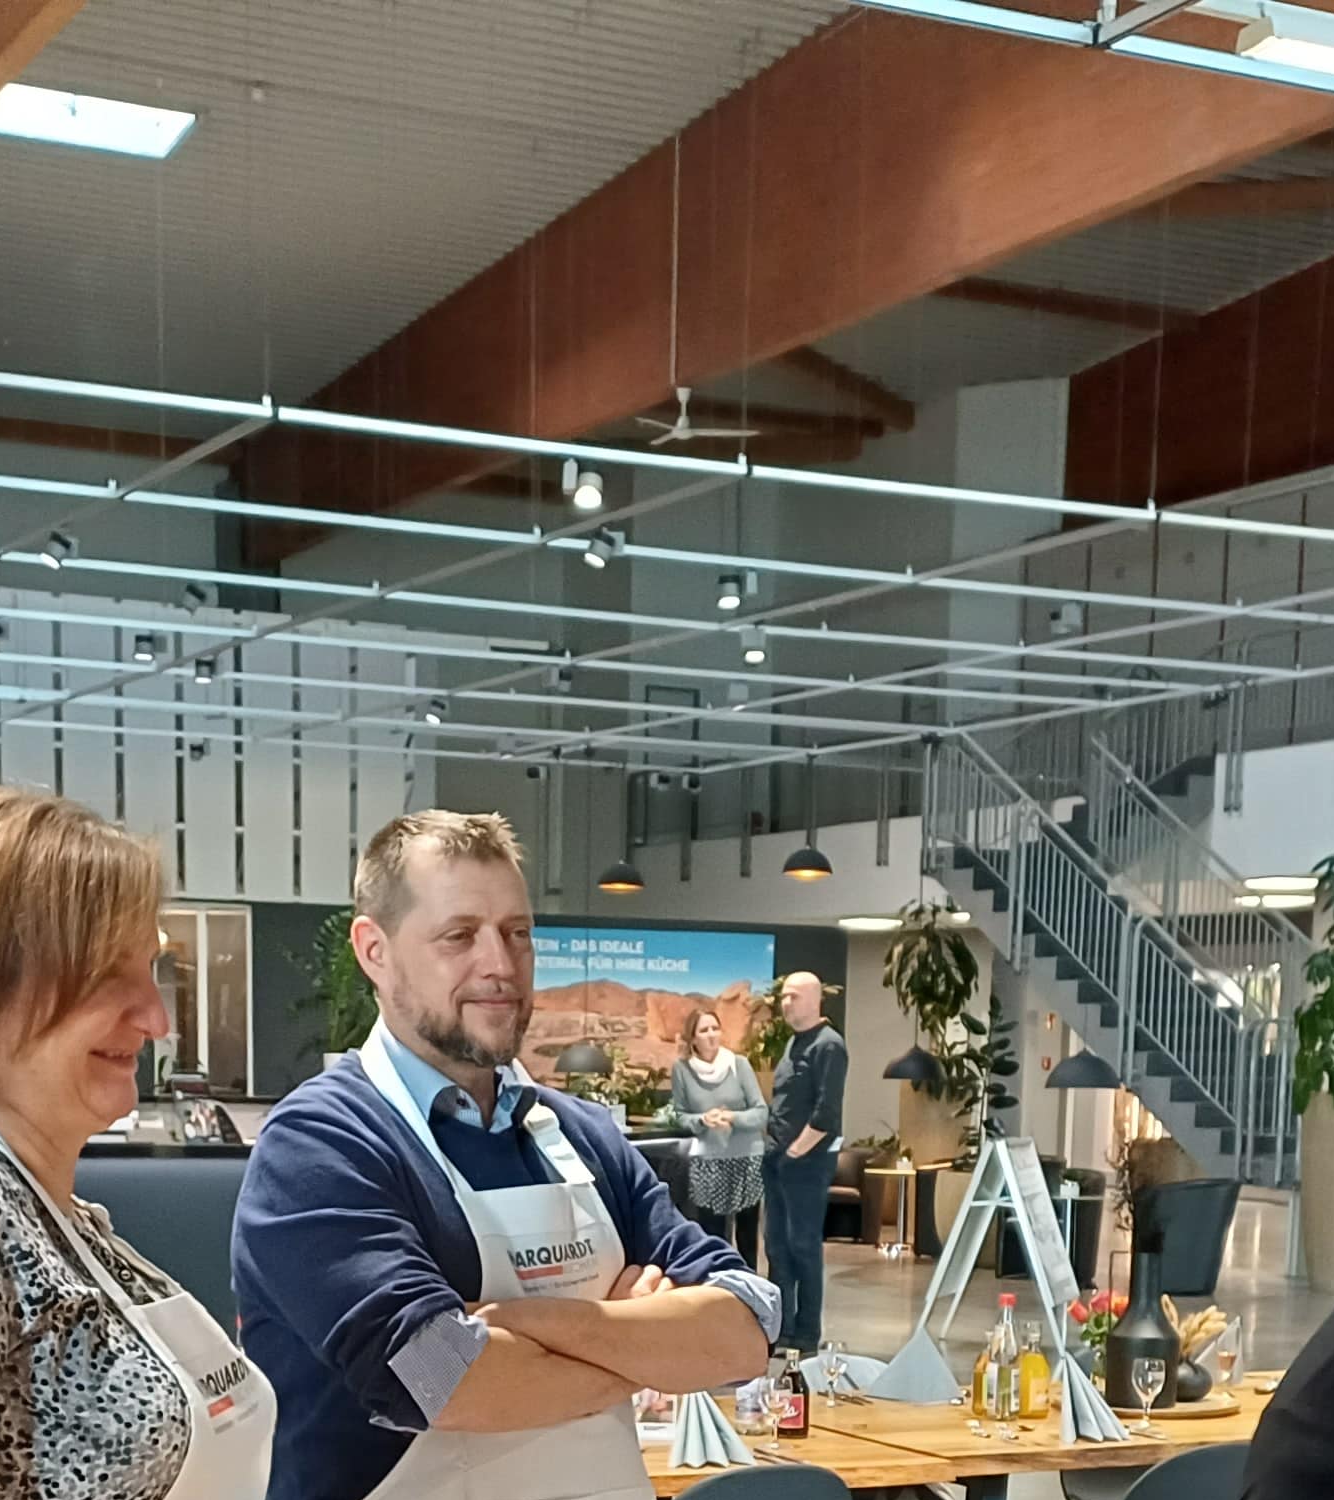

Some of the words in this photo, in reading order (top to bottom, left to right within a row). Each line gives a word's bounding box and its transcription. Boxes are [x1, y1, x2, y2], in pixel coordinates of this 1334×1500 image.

[571, 939, 597, 952] DAS
[599, 940, 644, 954] IDEALE
[587, 955, 614, 970] FÜR
[614, 957, 645, 972] IHRE
[646, 956, 690, 972] KÜCHE
